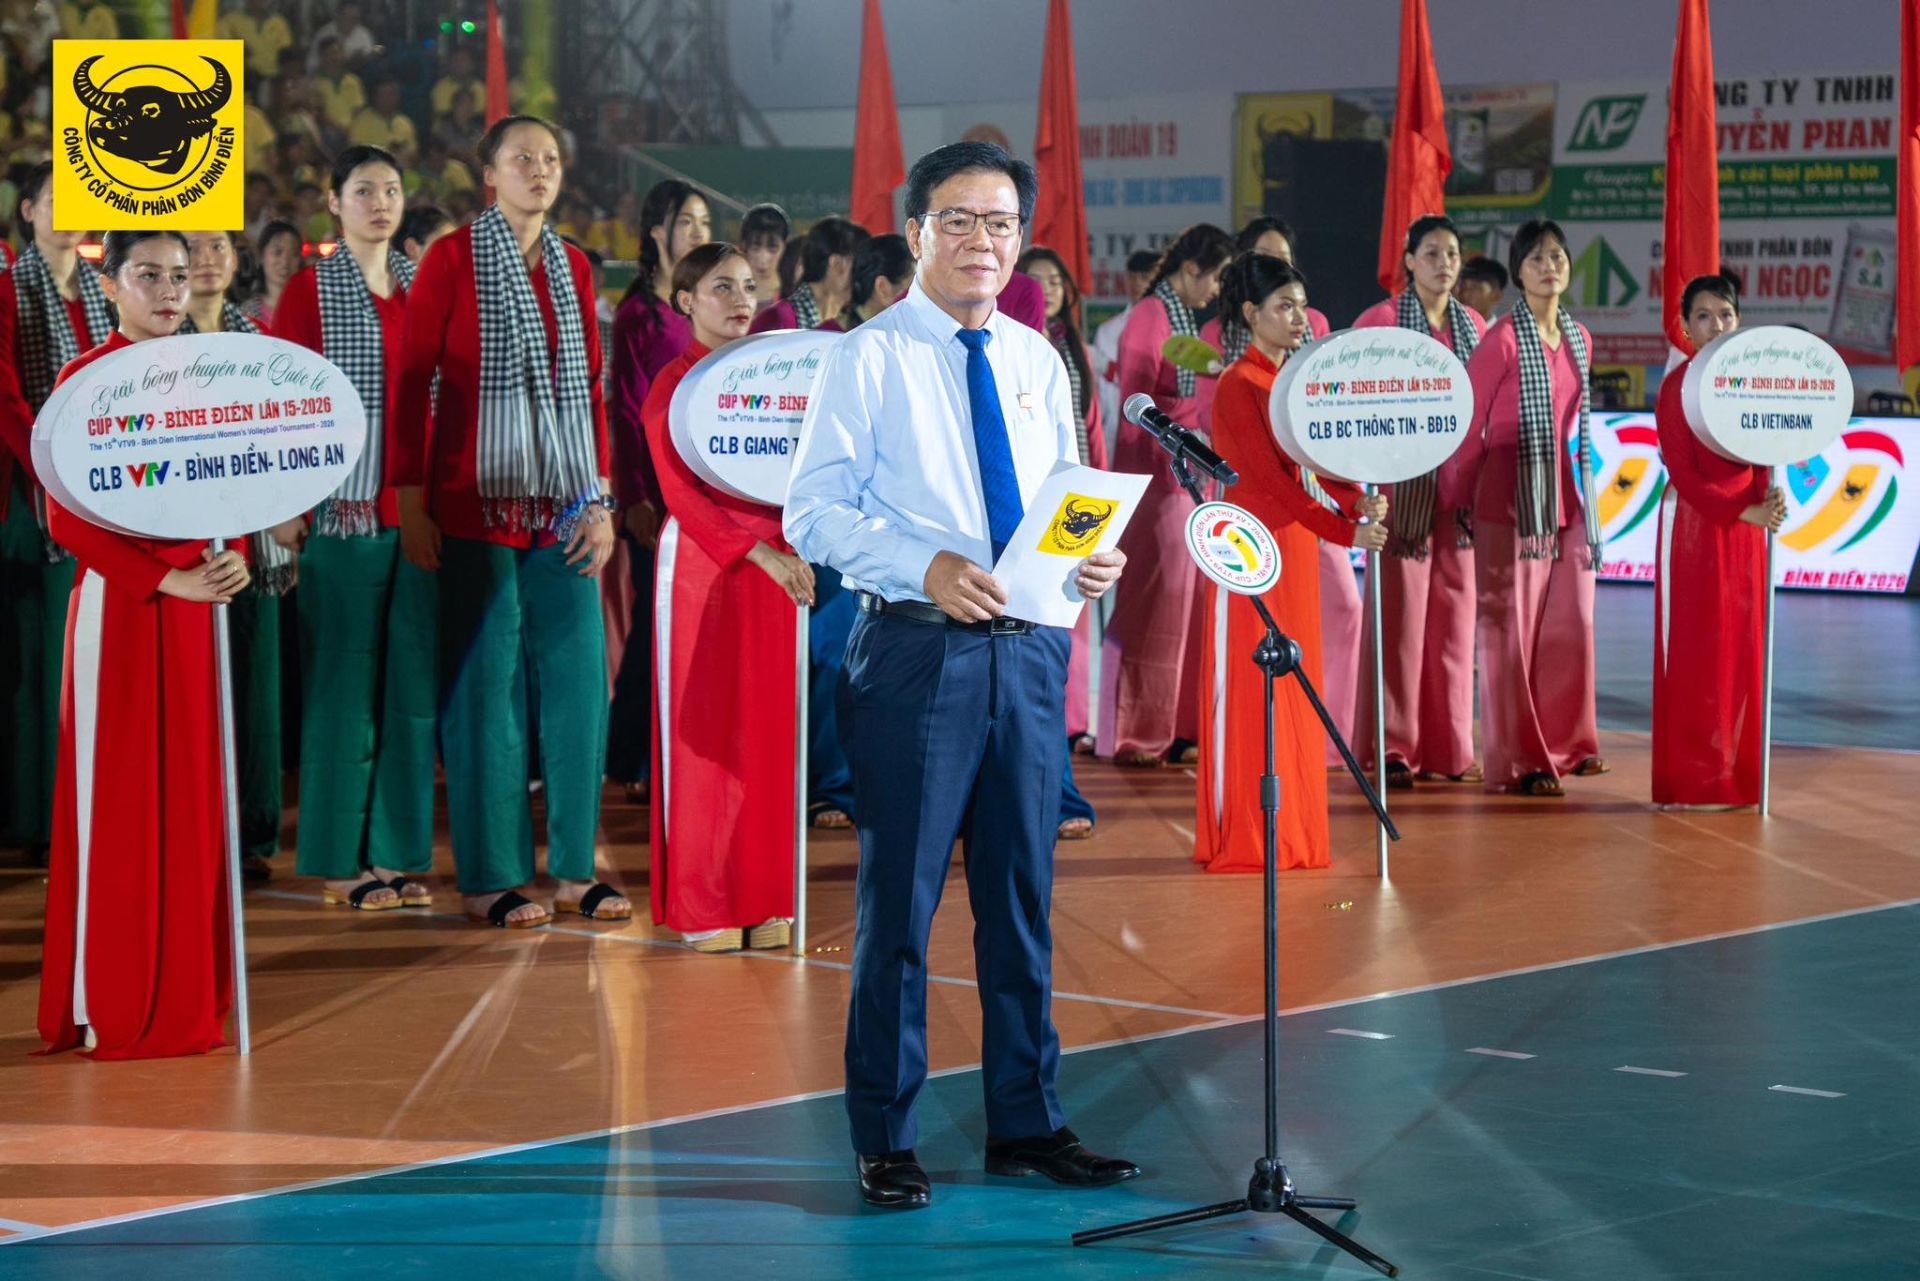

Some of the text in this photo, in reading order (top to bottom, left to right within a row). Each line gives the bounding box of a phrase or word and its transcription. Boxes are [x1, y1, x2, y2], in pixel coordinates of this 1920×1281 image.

[1763, 79, 1799, 105] TY
[1814, 76, 1895, 104] TNHH
[1803, 118, 1892, 150] PHAN
[1757, 262, 1832, 303] NGỌC
[1351, 378, 1376, 394] BÌNH
[115, 413, 155, 432] VTV9
[164, 406, 207, 428] BÌNH
[211, 400, 253, 424] ĐIỀN
[283, 396, 332, 417] 15-2026
[741, 395, 771, 410] VTV9
[175, 432, 216, 443] International
[217, 429, 246, 438] Women's
[248, 425, 278, 436] Volleyball
[279, 422, 315, 432] Tournament
[1309, 421, 1332, 440] CLB
[1336, 420, 1352, 438] BC
[1355, 413, 1395, 437] THÔNG
[1397, 417, 1417, 435] TIN
[1428, 415, 1457, 433] BĐ19
[1741, 412, 1812, 429] CLB VIETINBANK
[709, 436, 738, 454] CLB
[744, 437, 788, 455] GIANG
[89, 465, 123, 492] CLB
[126, 460, 170, 488] VTV
[185, 452, 225, 481] BÌNH
[278, 446, 320, 471] LONG
[324, 443, 345, 466] AN
